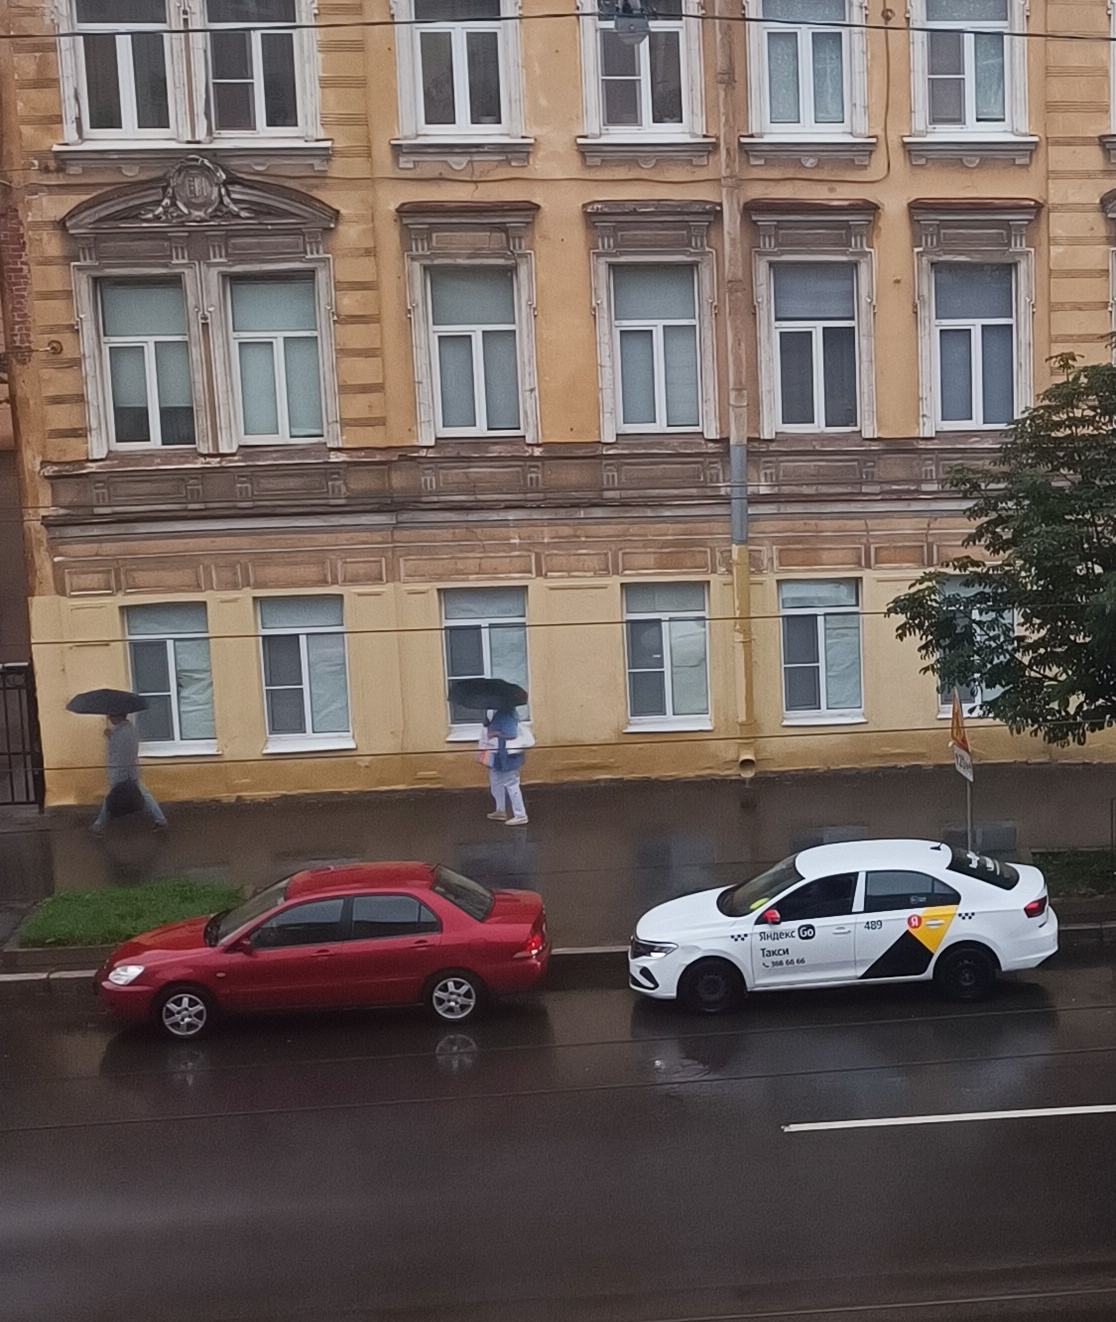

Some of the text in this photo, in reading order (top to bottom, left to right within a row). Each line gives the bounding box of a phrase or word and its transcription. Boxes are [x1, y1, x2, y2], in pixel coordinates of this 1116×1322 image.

[863, 920, 883, 930] 489
[910, 916, 919, 927] Я
[759, 926, 814, 941] Яндекс Go
[760, 948, 789, 958] Такси
